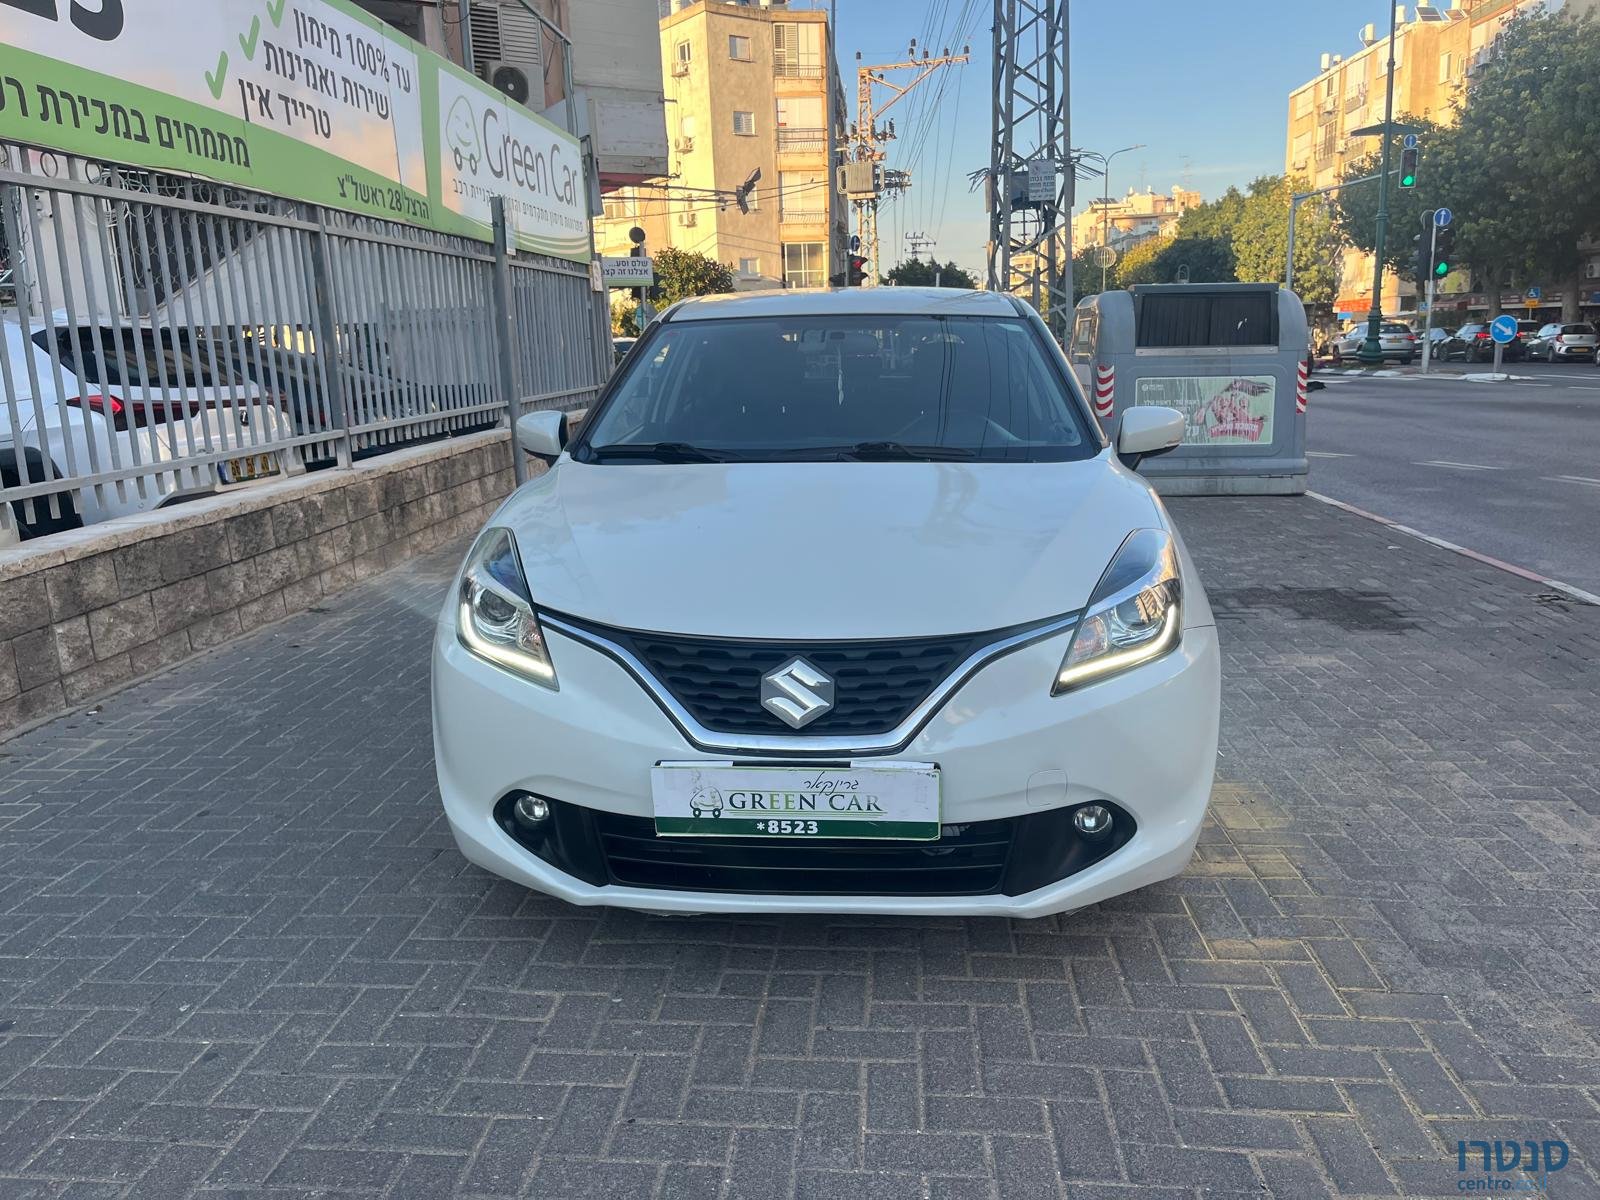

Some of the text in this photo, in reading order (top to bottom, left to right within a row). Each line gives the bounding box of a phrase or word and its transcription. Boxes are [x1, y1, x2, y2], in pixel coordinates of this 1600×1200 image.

[293, 8, 411, 94] עד 100% מימון
[263, 40, 389, 120] שירות ואמינות
[37, 84, 150, 144] במכירת
[238, 78, 331, 139] טרייד אין
[155, 114, 251, 168] מתמחים
[483, 108, 578, 207] Green Car
[387, 188, 402, 212] 28
[453, 178, 468, 195] רכב
[403, 191, 430, 219] הרצל
[628, 268, 649, 276] אצלנו
[631, 259, 648, 267] שלם
[803, 771, 859, 796] גרינקאר
[728, 792, 884, 811] GREEN CAR
